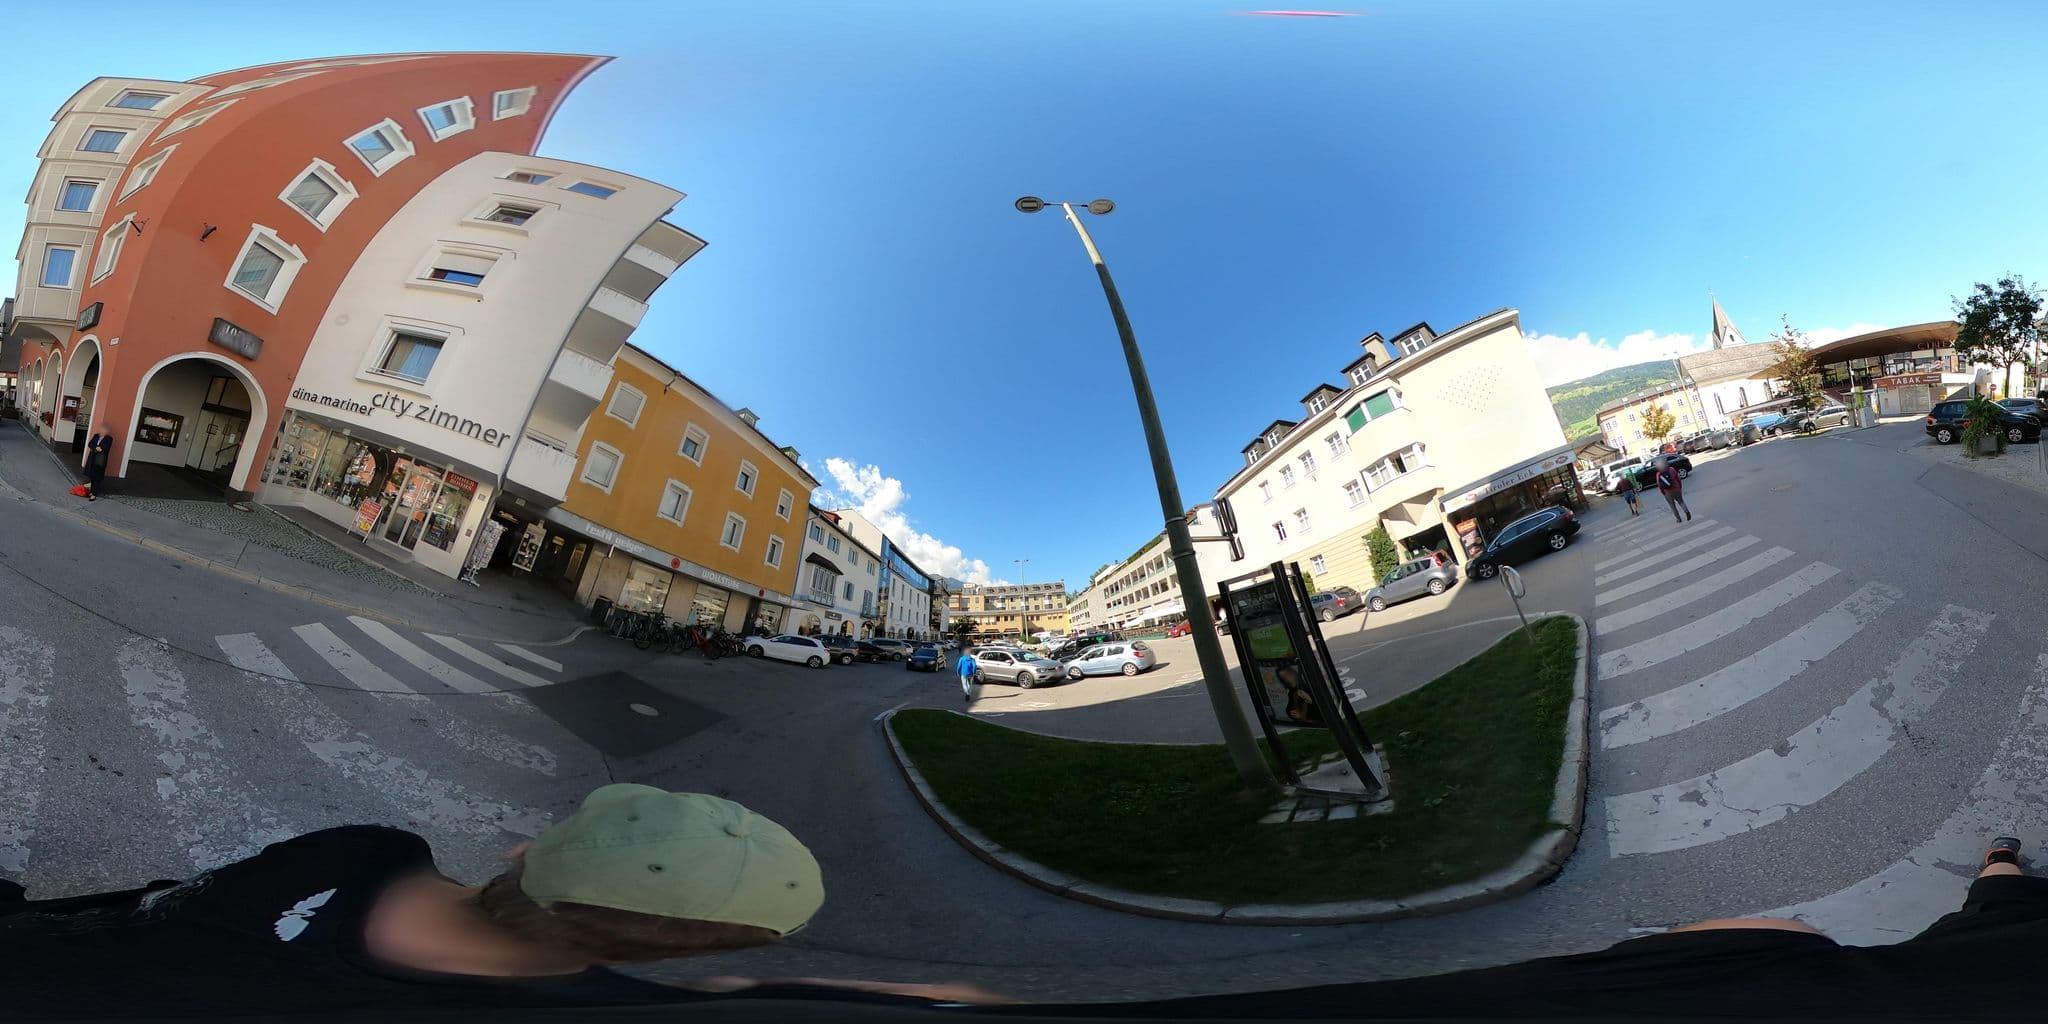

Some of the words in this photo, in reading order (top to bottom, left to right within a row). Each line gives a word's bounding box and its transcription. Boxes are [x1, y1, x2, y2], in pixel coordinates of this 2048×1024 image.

[1891, 376, 1921, 385] TABAK
[292, 387, 318, 402] dina
[320, 395, 375, 416] mariner
[372, 391, 413, 418] city
[415, 404, 510, 448] zimmer
[1485, 478, 1515, 495] Tiroler
[1517, 469, 1535, 481] Eck
